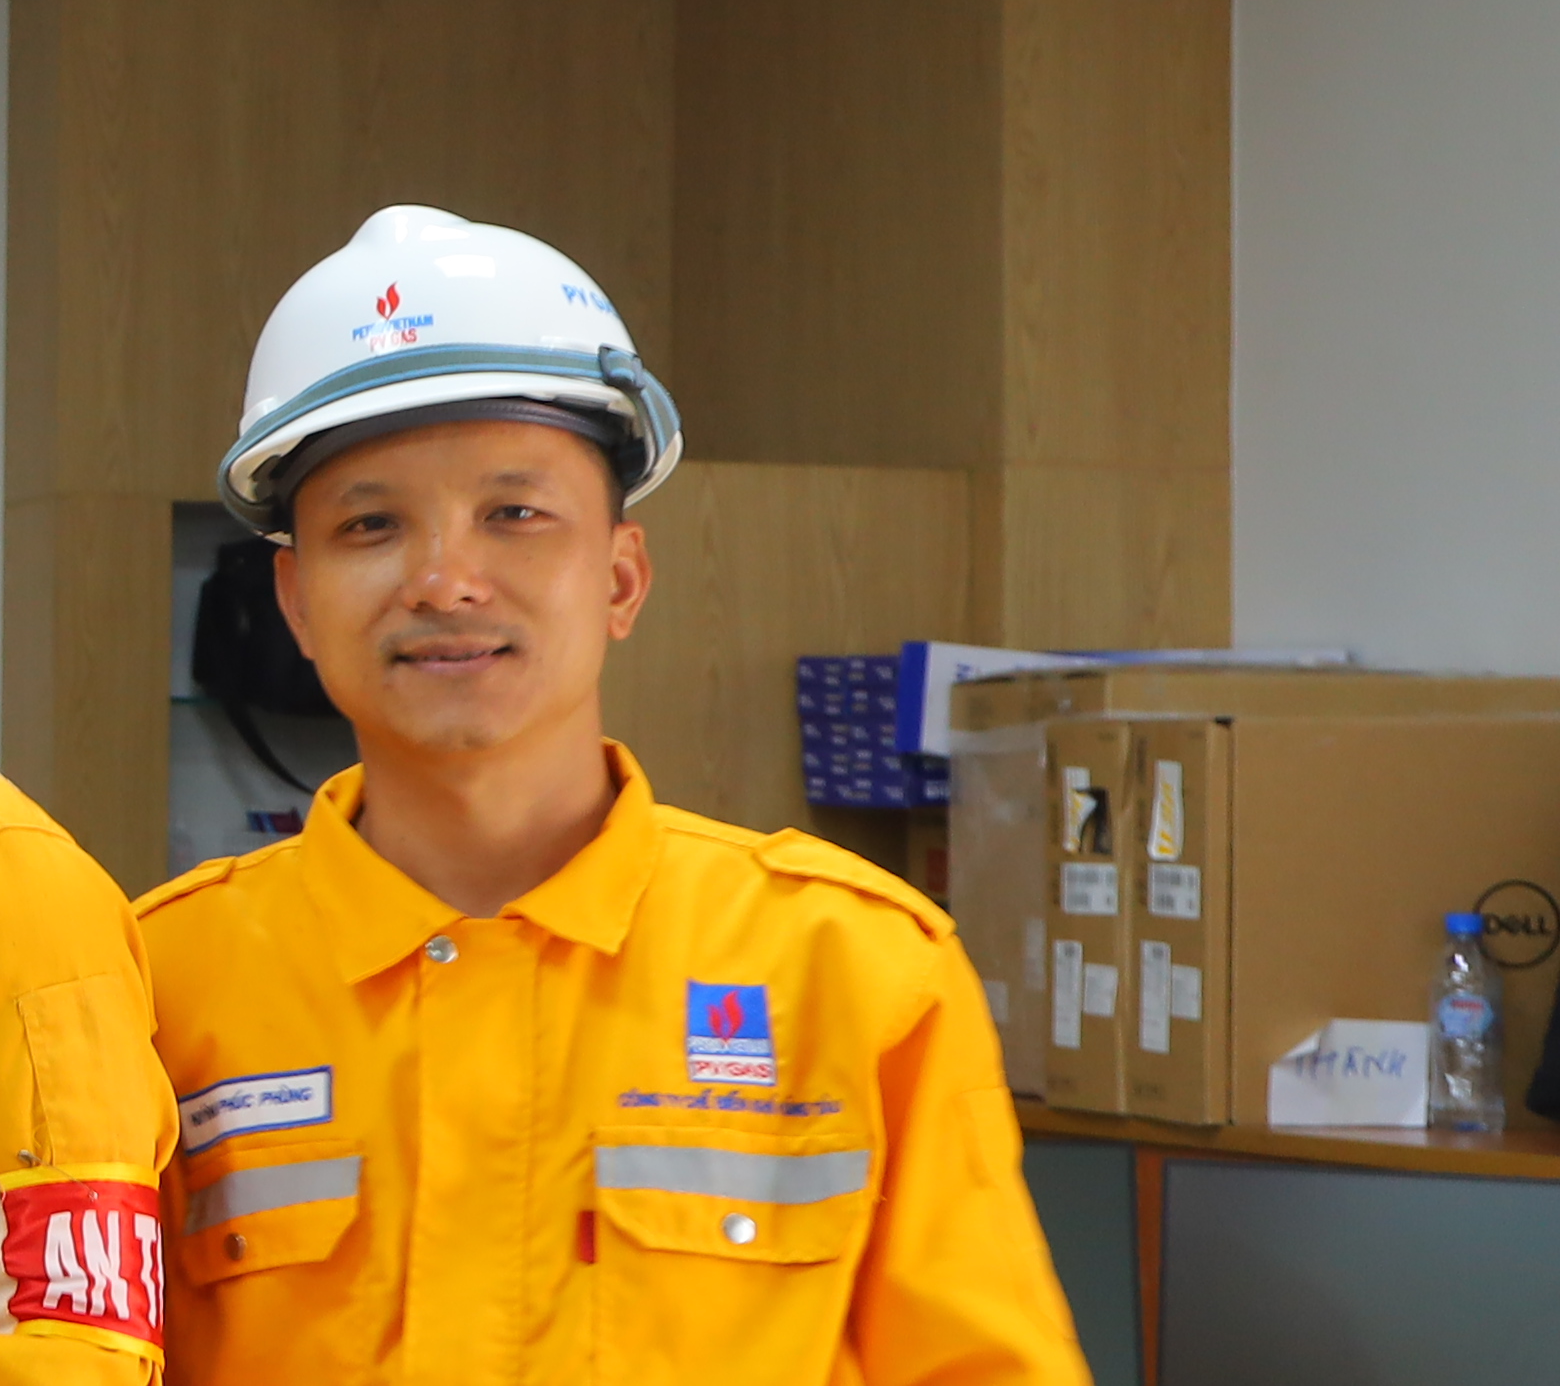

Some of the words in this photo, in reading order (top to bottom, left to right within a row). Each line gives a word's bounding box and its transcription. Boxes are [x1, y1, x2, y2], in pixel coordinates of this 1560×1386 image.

[1485, 914, 1552, 936] DELL
[43, 1209, 130, 1321] AN
[134, 1212, 165, 1332] T
